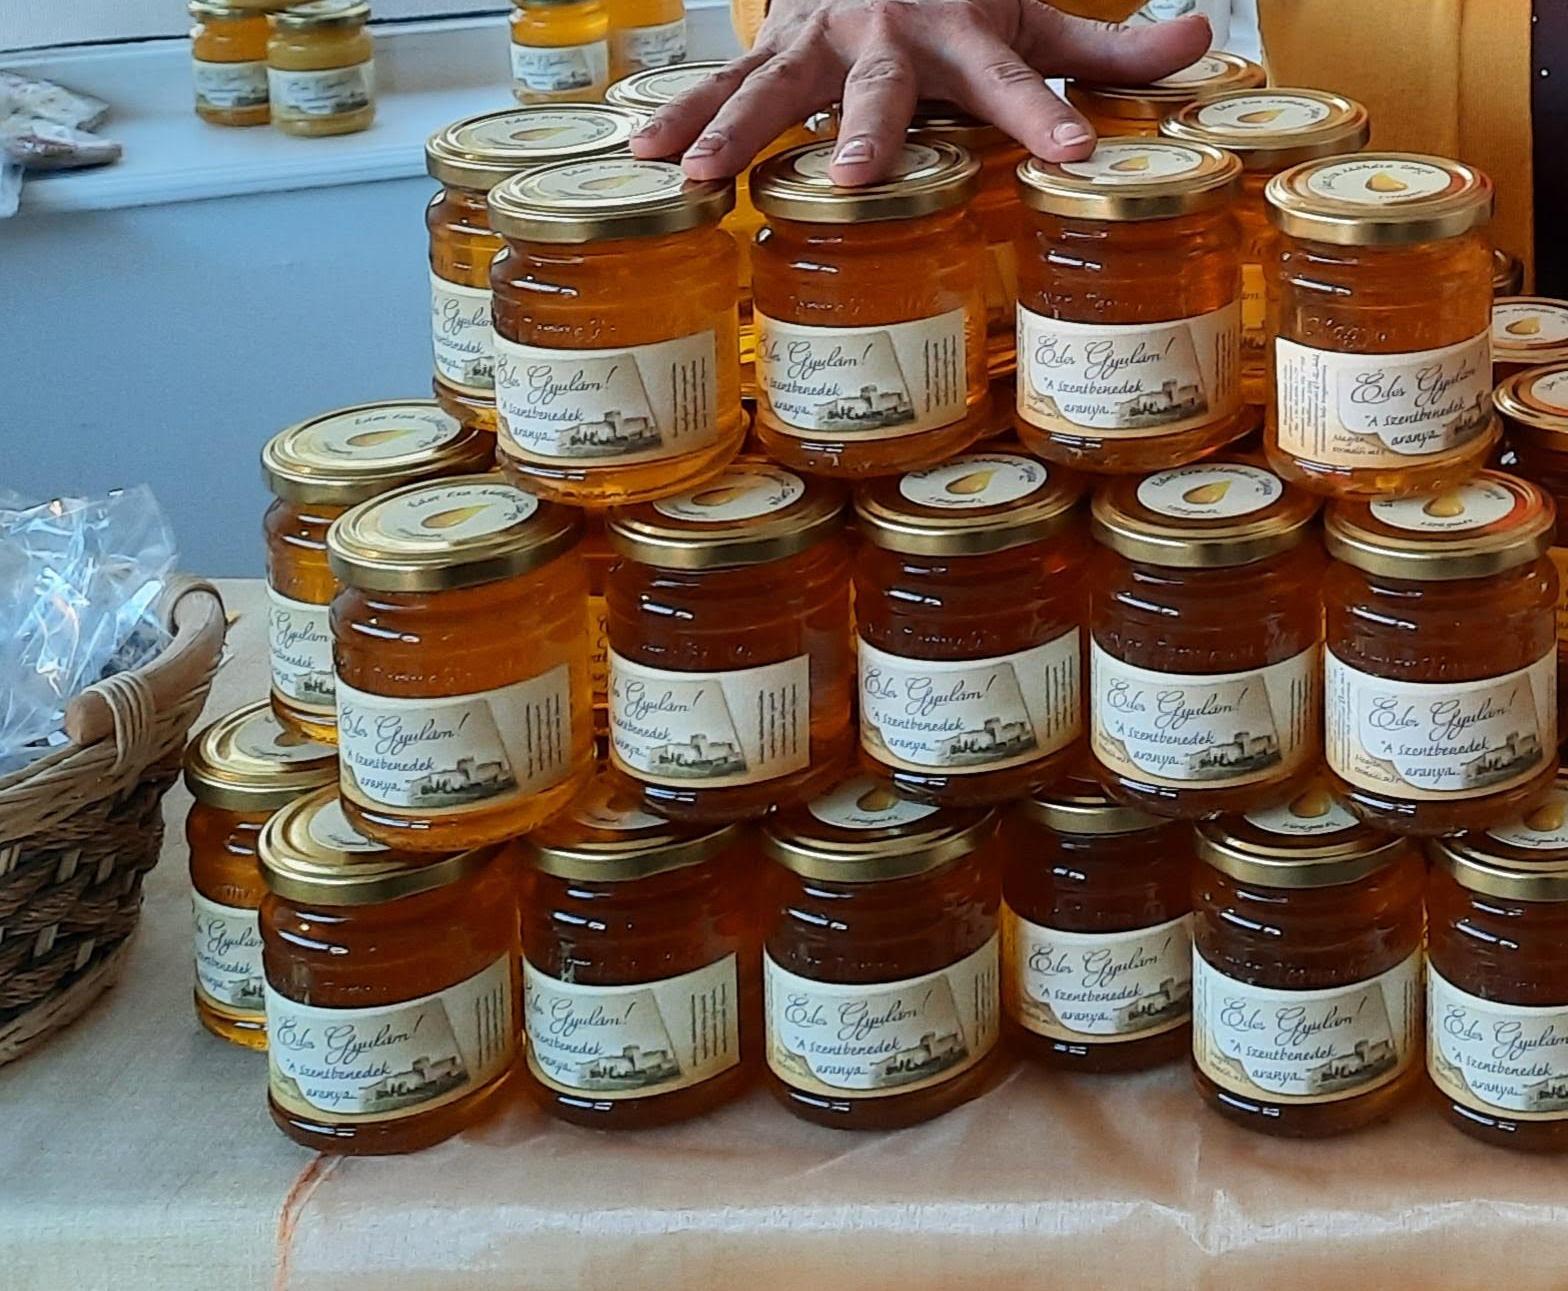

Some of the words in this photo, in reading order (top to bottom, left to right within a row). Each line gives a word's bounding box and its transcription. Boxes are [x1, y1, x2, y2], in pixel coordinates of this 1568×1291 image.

[787, 341, 873, 380] Gyulám!
[527, 365, 618, 404] Gyulám!
[624, 679, 704, 720] Gyulám!
[375, 712, 470, 755] Gyulám!
[550, 998, 636, 1037] Gyulám!
